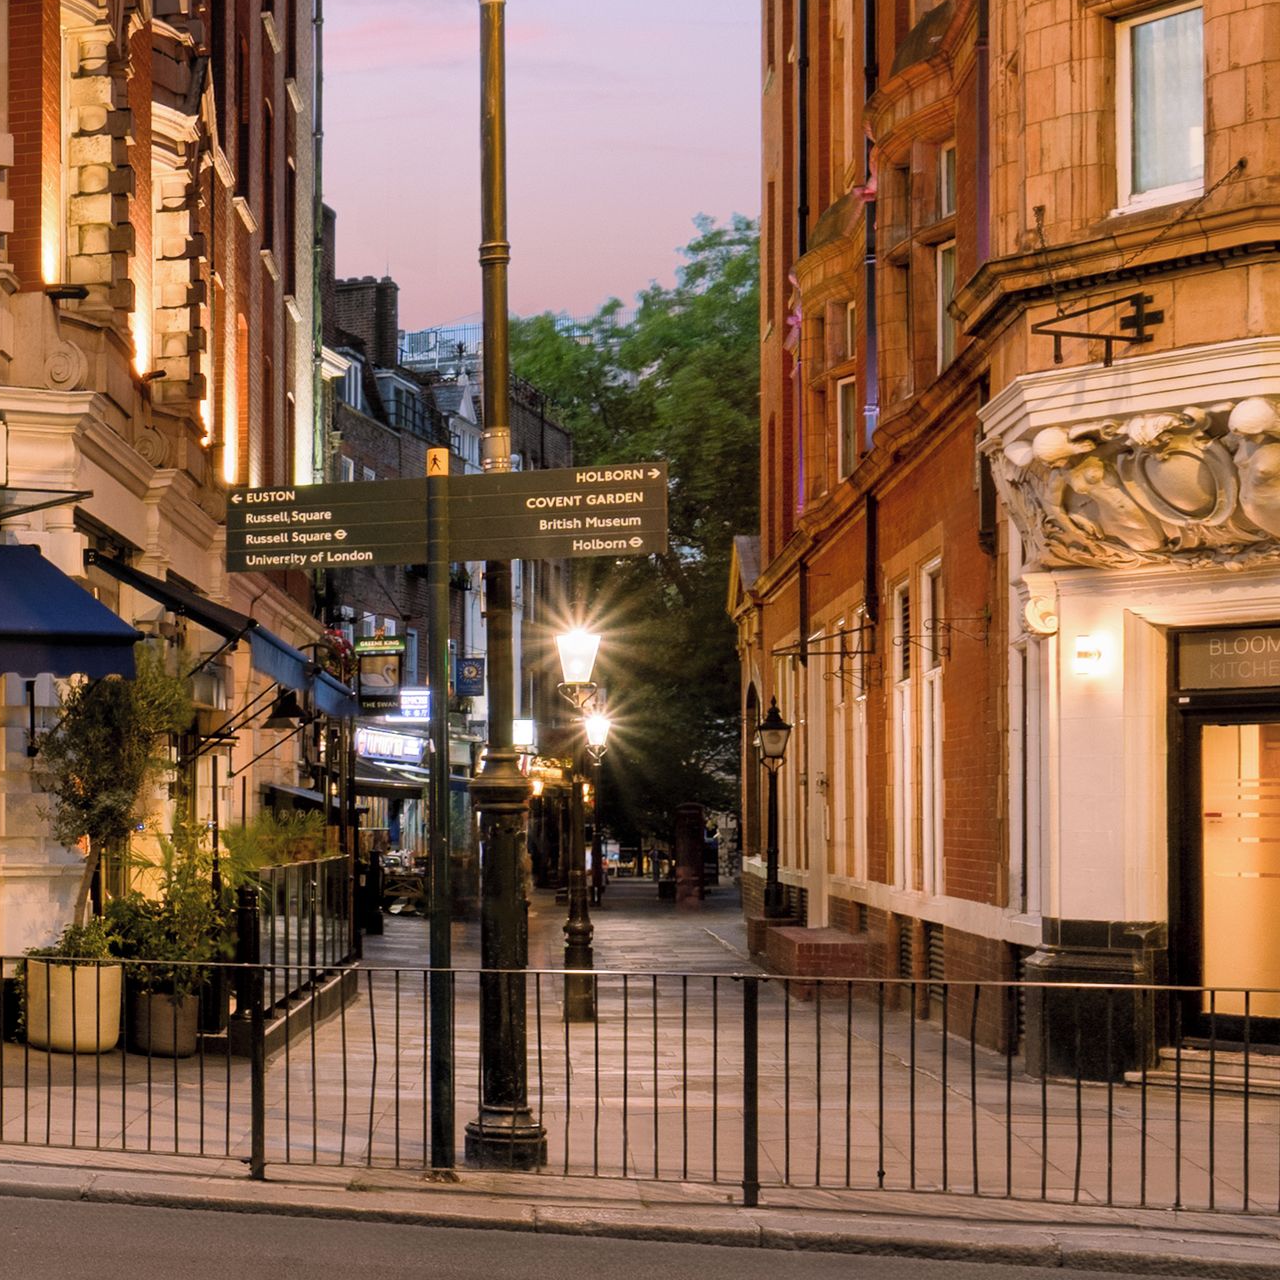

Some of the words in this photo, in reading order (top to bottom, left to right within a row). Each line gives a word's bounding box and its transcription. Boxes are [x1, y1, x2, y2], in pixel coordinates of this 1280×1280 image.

[576, 469, 643, 483] HOLBORN
[246, 491, 296, 503] EUSTON
[526, 495, 582, 508] COVENT
[586, 492, 644, 505] GARDEN
[291, 510, 332, 523] Square
[539, 518, 582, 530] British
[585, 517, 642, 528] Museum
[245, 532, 289, 545] Russell
[291, 531, 332, 543] Square
[573, 538, 627, 551] Holborn
[246, 553, 307, 566] University
[310, 551, 325, 563] of
[327, 550, 373, 562] London
[362, 701, 376, 709] THE
[377, 700, 399, 708] SWAN
